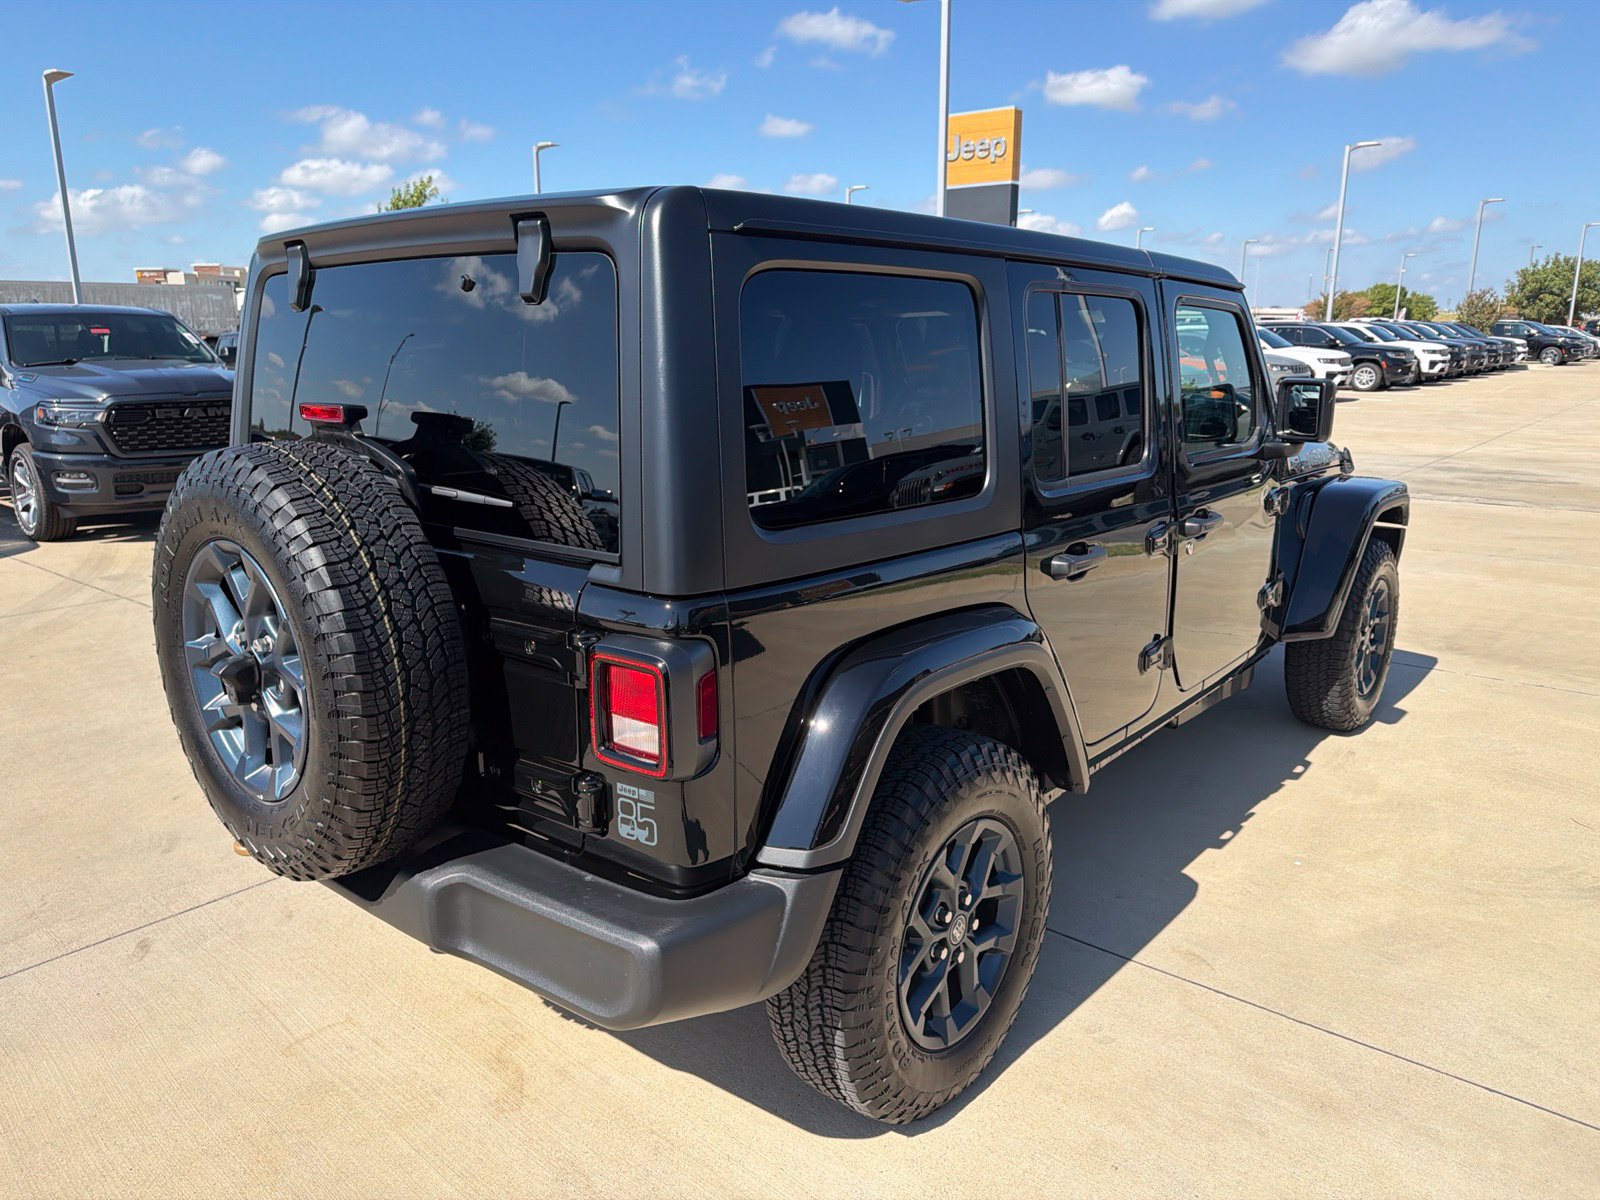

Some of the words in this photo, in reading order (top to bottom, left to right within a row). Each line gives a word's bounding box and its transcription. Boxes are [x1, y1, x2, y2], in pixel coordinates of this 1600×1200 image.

[946, 135, 1006, 164] Jeep
[155, 406, 230, 419] RAM
[618, 784, 637, 796] Jeep
[617, 798, 658, 846] 85
[1021, 837, 1046, 967] NEXEN
[886, 937, 911, 1072] ROADIAN
